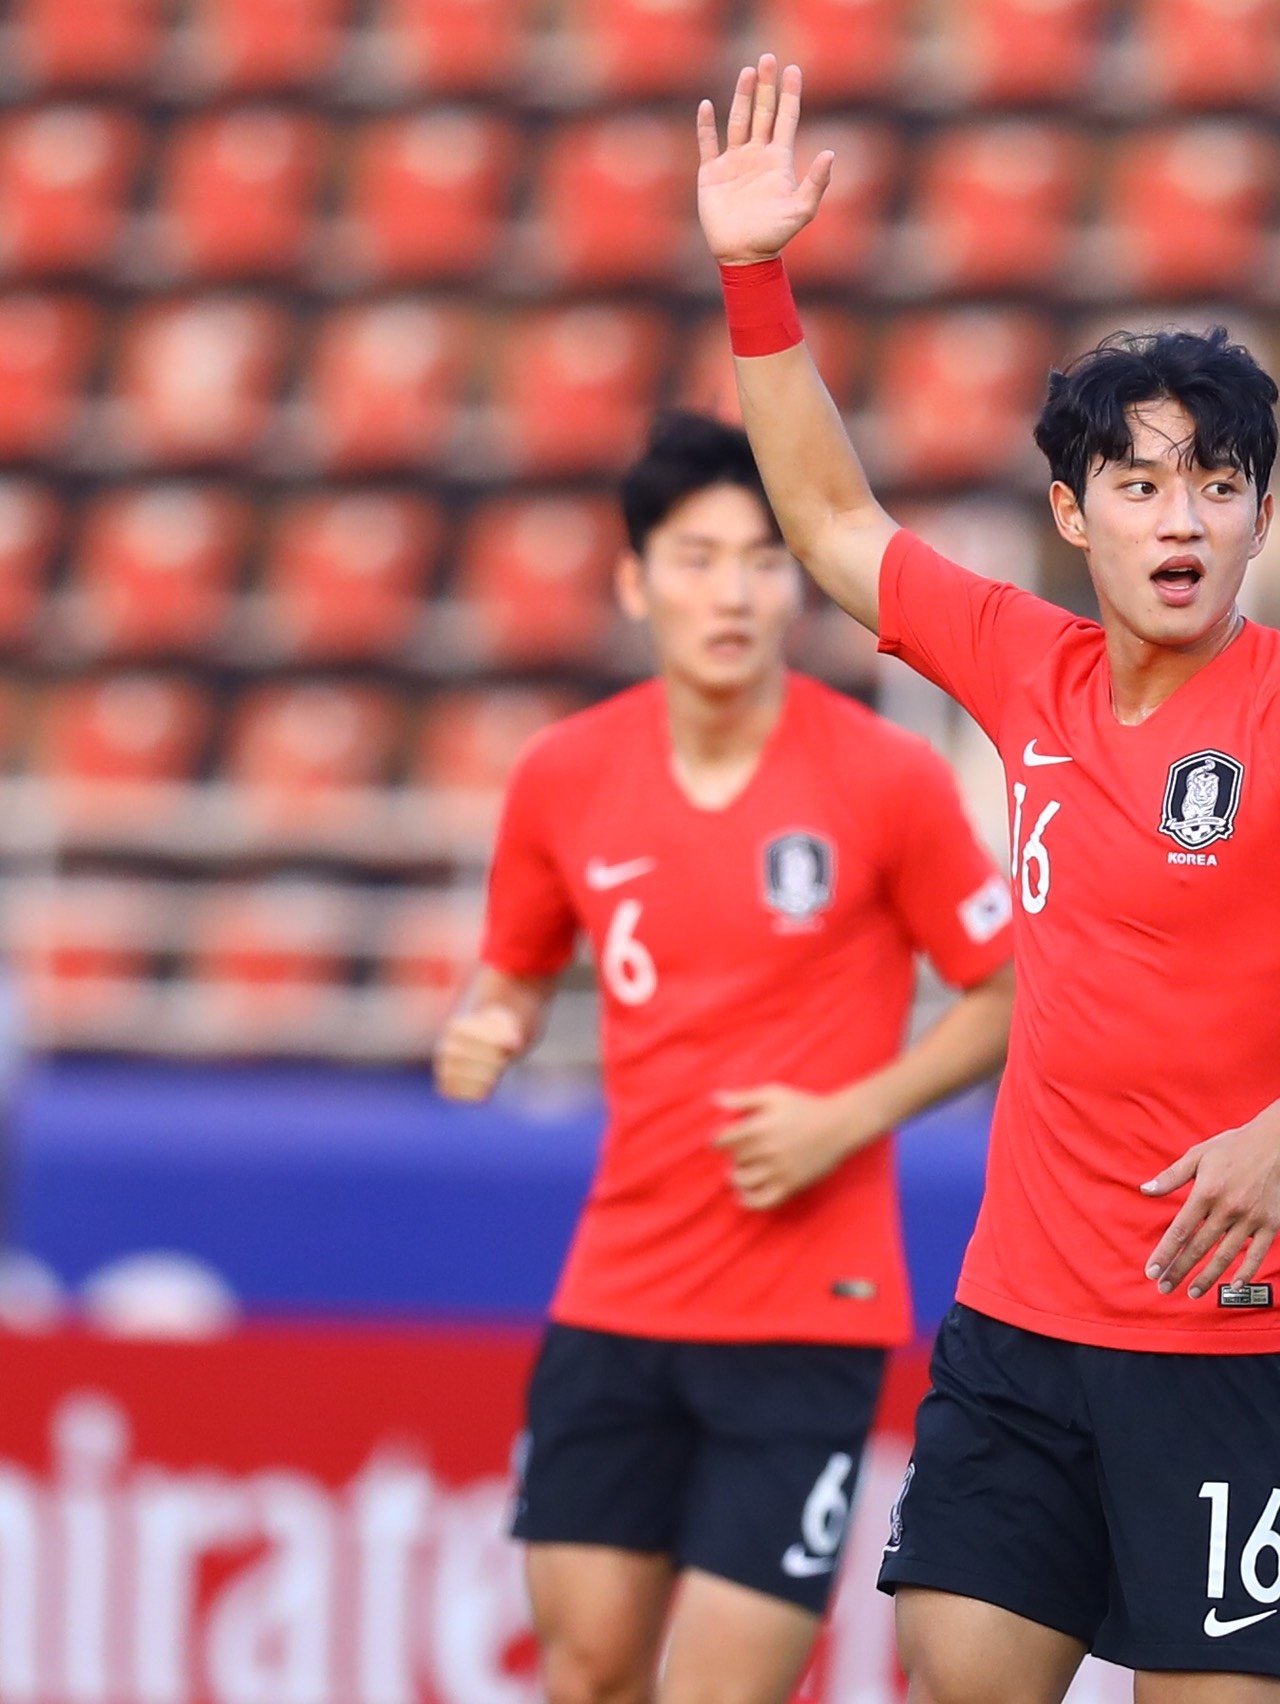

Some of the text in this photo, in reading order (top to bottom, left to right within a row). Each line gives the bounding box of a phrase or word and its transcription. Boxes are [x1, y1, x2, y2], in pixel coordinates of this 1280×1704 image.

[1010, 781, 1061, 914] 16
[1167, 852, 1217, 866] KOREA
[602, 899, 658, 1006] 6
[802, 1452, 852, 1556] 6
